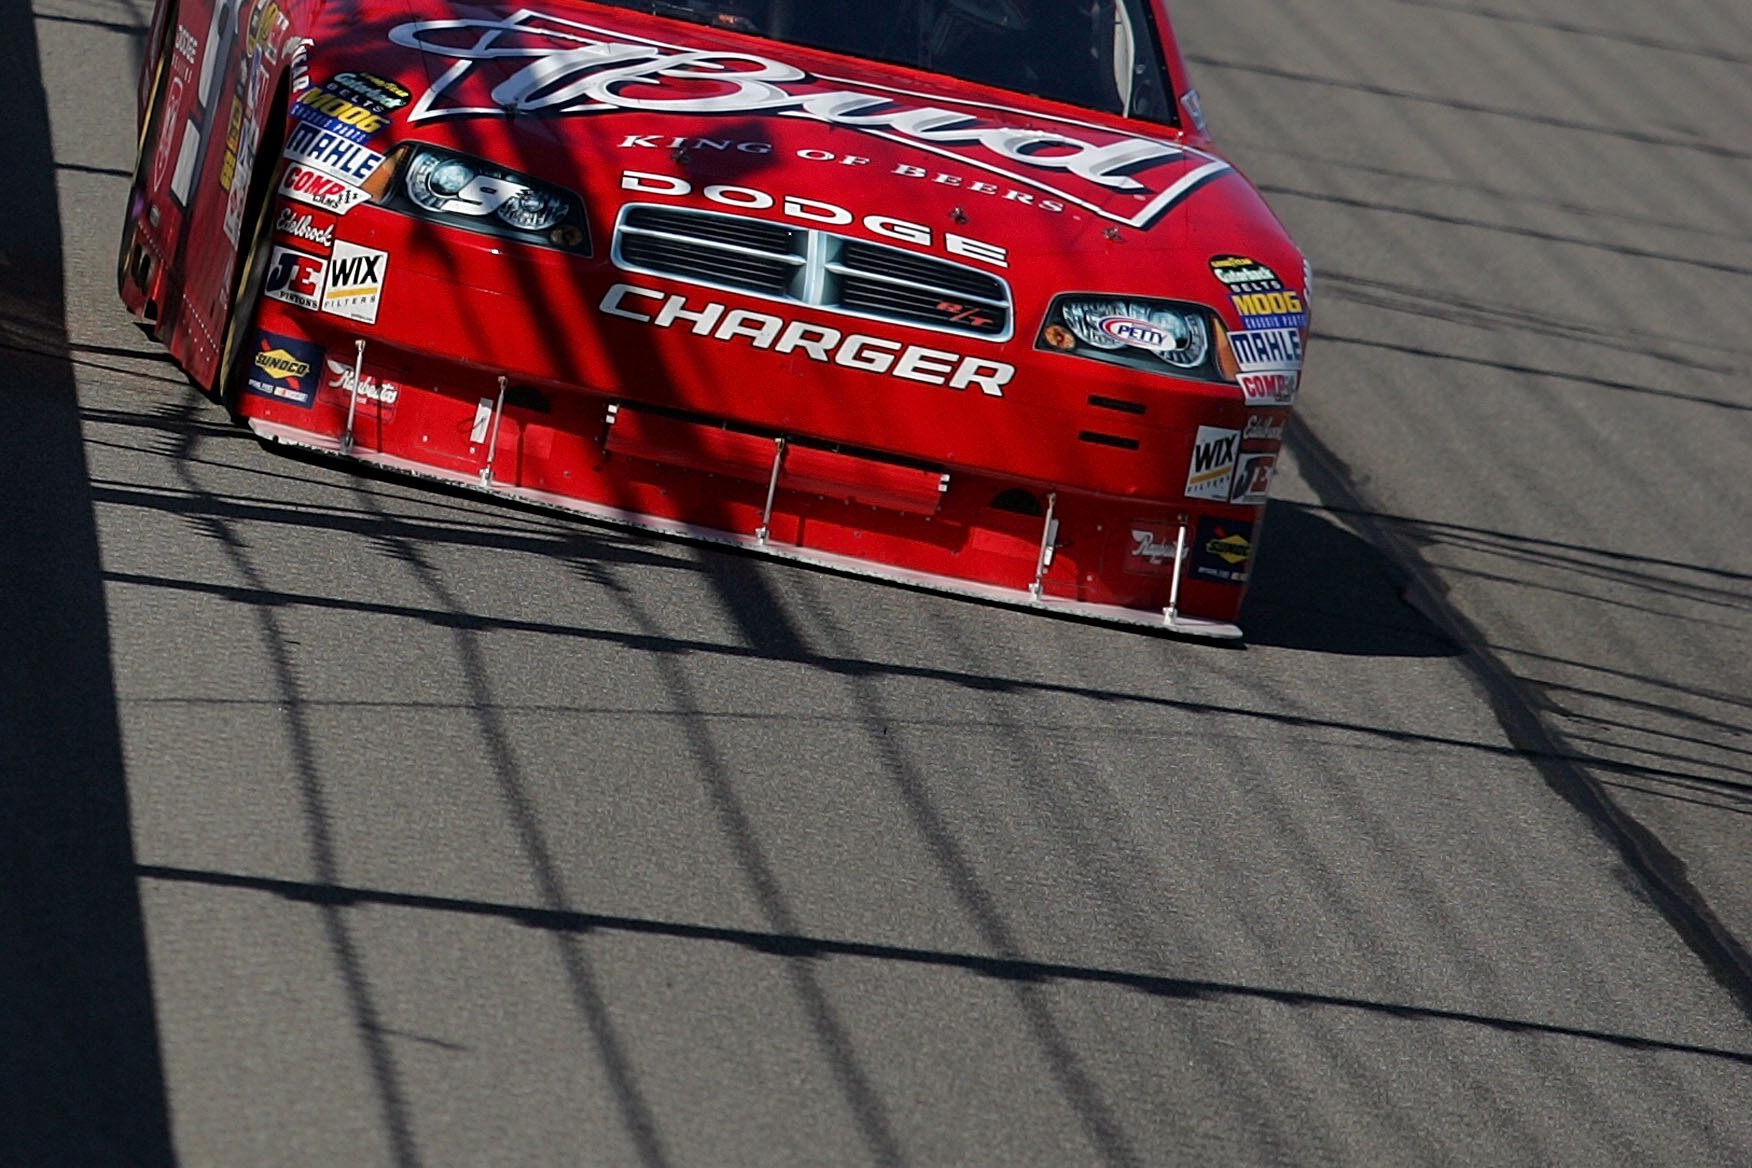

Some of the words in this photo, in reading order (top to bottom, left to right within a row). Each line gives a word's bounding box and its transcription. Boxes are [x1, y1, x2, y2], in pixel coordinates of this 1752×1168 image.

[295, 85, 392, 135] MOOG
[325, 81, 385, 113] BELTS
[285, 125, 383, 181] MAHLE
[283, 165, 347, 197] COMP
[616, 133, 774, 157] KING
[795, 147, 871, 167] OF
[890, 162, 1067, 214] BEERS
[275, 206, 335, 247] Edelbrock
[619, 169, 1011, 269] DODGE
[265, 251, 324, 298] JE
[330, 254, 384, 288] WIX
[1229, 280, 1282, 293] BELTS
[278, 289, 319, 310] PISTONS
[323, 295, 377, 309] FILTERS
[1230, 290, 1304, 317] MOOG
[597, 282, 1017, 398] CHARGER
[1116, 324, 1170, 346] PETTY
[1229, 330, 1302, 364] MAHLE
[255, 353, 311, 376] SUNOCO
[1241, 374, 1287, 398] COMP
[1194, 432, 1239, 474] WIX
